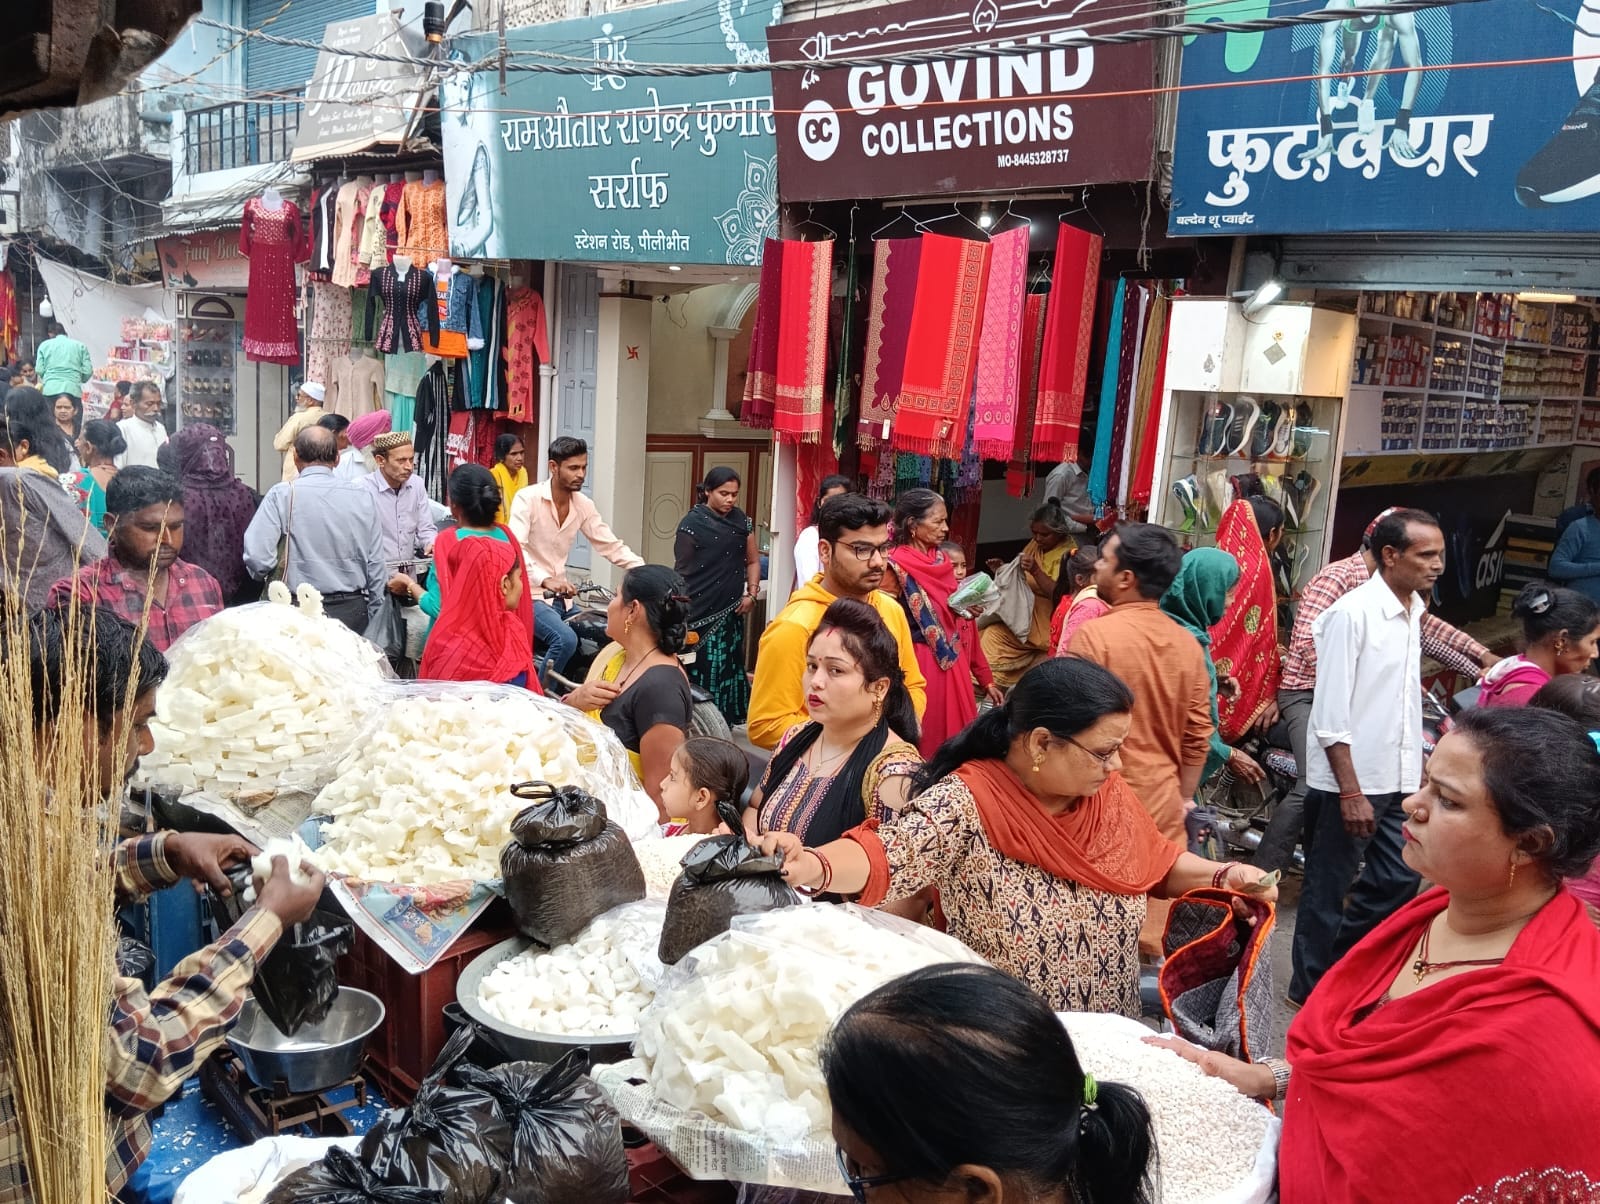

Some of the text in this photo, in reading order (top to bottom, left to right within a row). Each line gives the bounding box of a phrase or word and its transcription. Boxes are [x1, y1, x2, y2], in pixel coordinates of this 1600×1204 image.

[848, 29, 1095, 115] GOVIND
[500, 87, 777, 156] रामऔतार राजेन्द्र कुमार
[861, 103, 1074, 157] COLLECTIONS
[588, 157, 669, 209] सर्राफ
[997, 149, 1070, 168] MO-8445328737
[574, 229, 690, 253] स्टेशन रोड, पीलीभीत
[1208, 215, 1221, 228] शू
